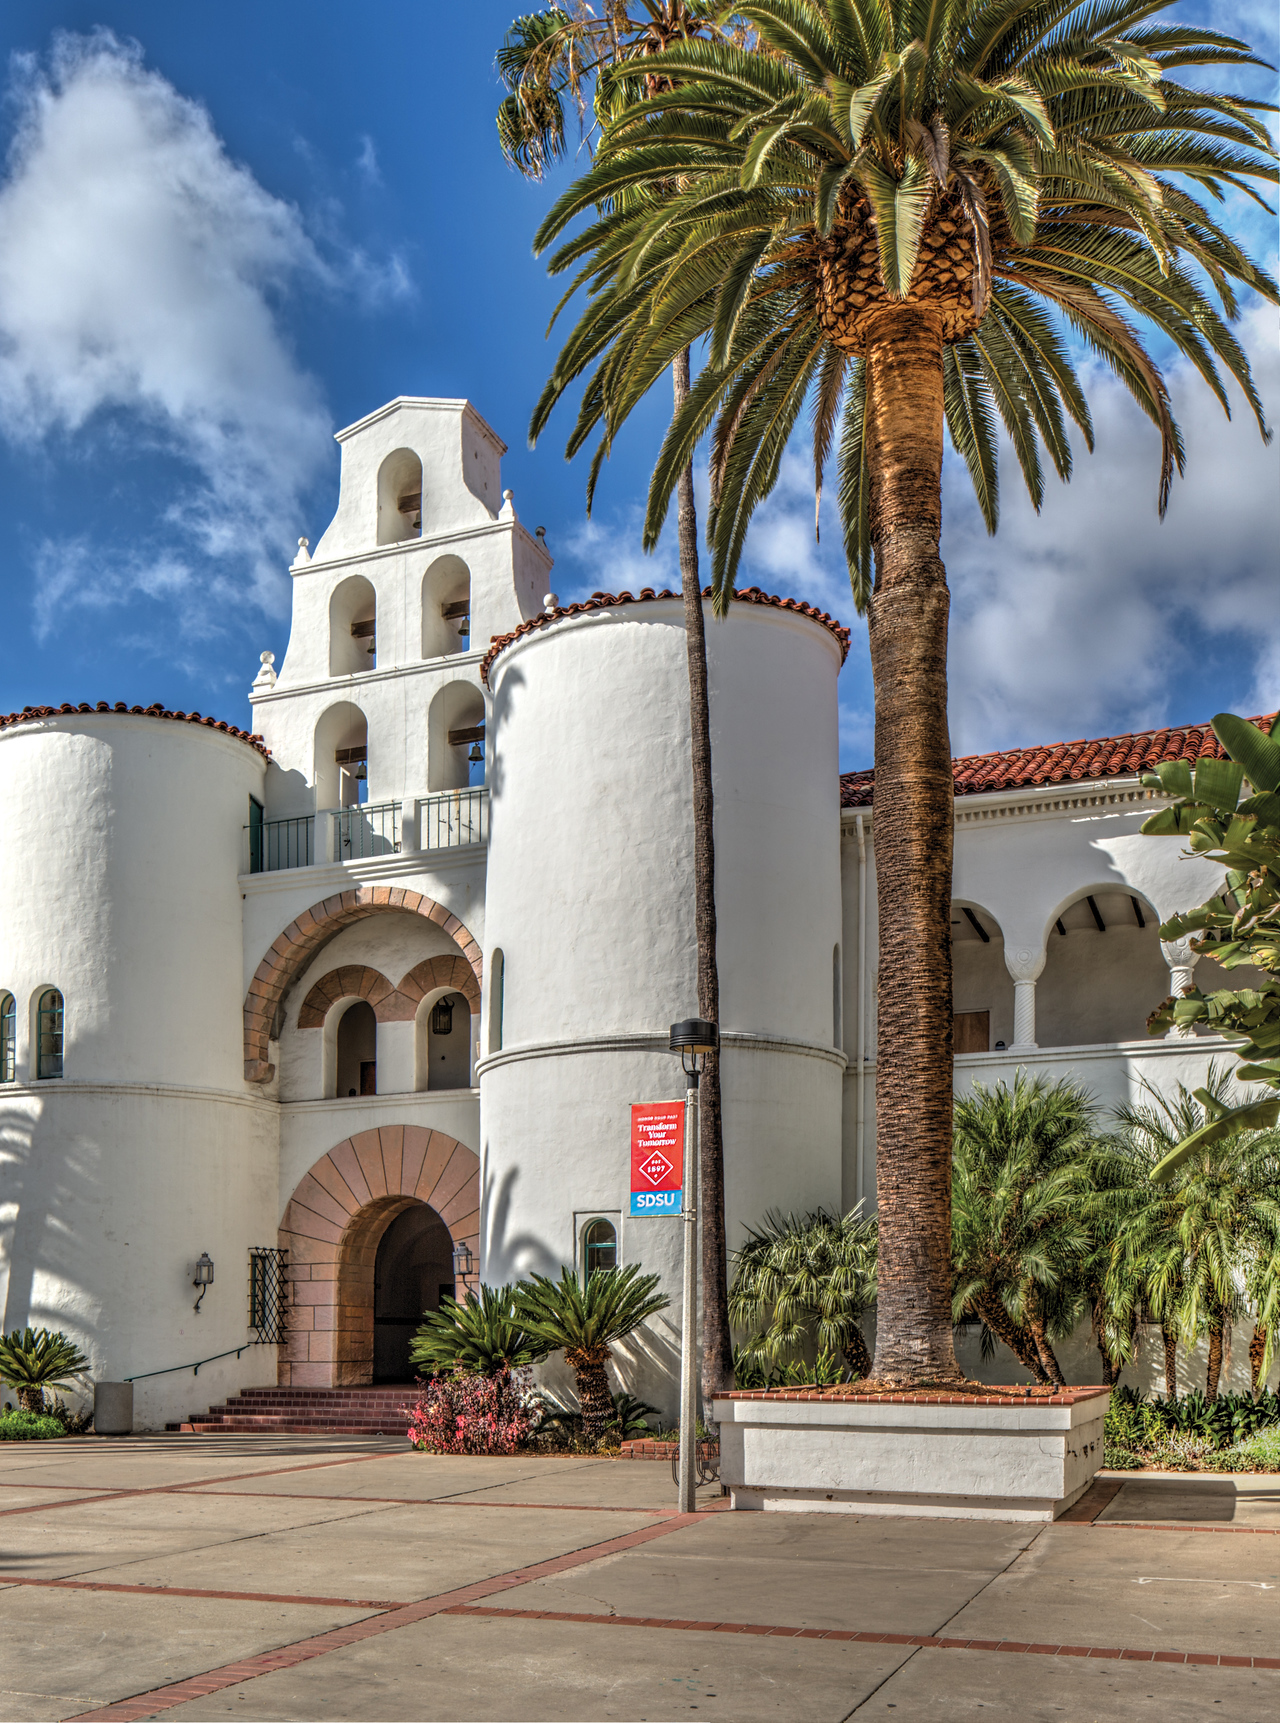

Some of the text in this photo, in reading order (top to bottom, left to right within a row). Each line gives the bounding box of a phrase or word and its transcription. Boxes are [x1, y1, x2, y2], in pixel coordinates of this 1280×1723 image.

[637, 1122, 677, 1132] Transform
[648, 1131, 667, 1139] Your
[637, 1139, 677, 1147] Tomorrow
[647, 1165, 665, 1173] 1897
[637, 1193, 675, 1208] SDSU
